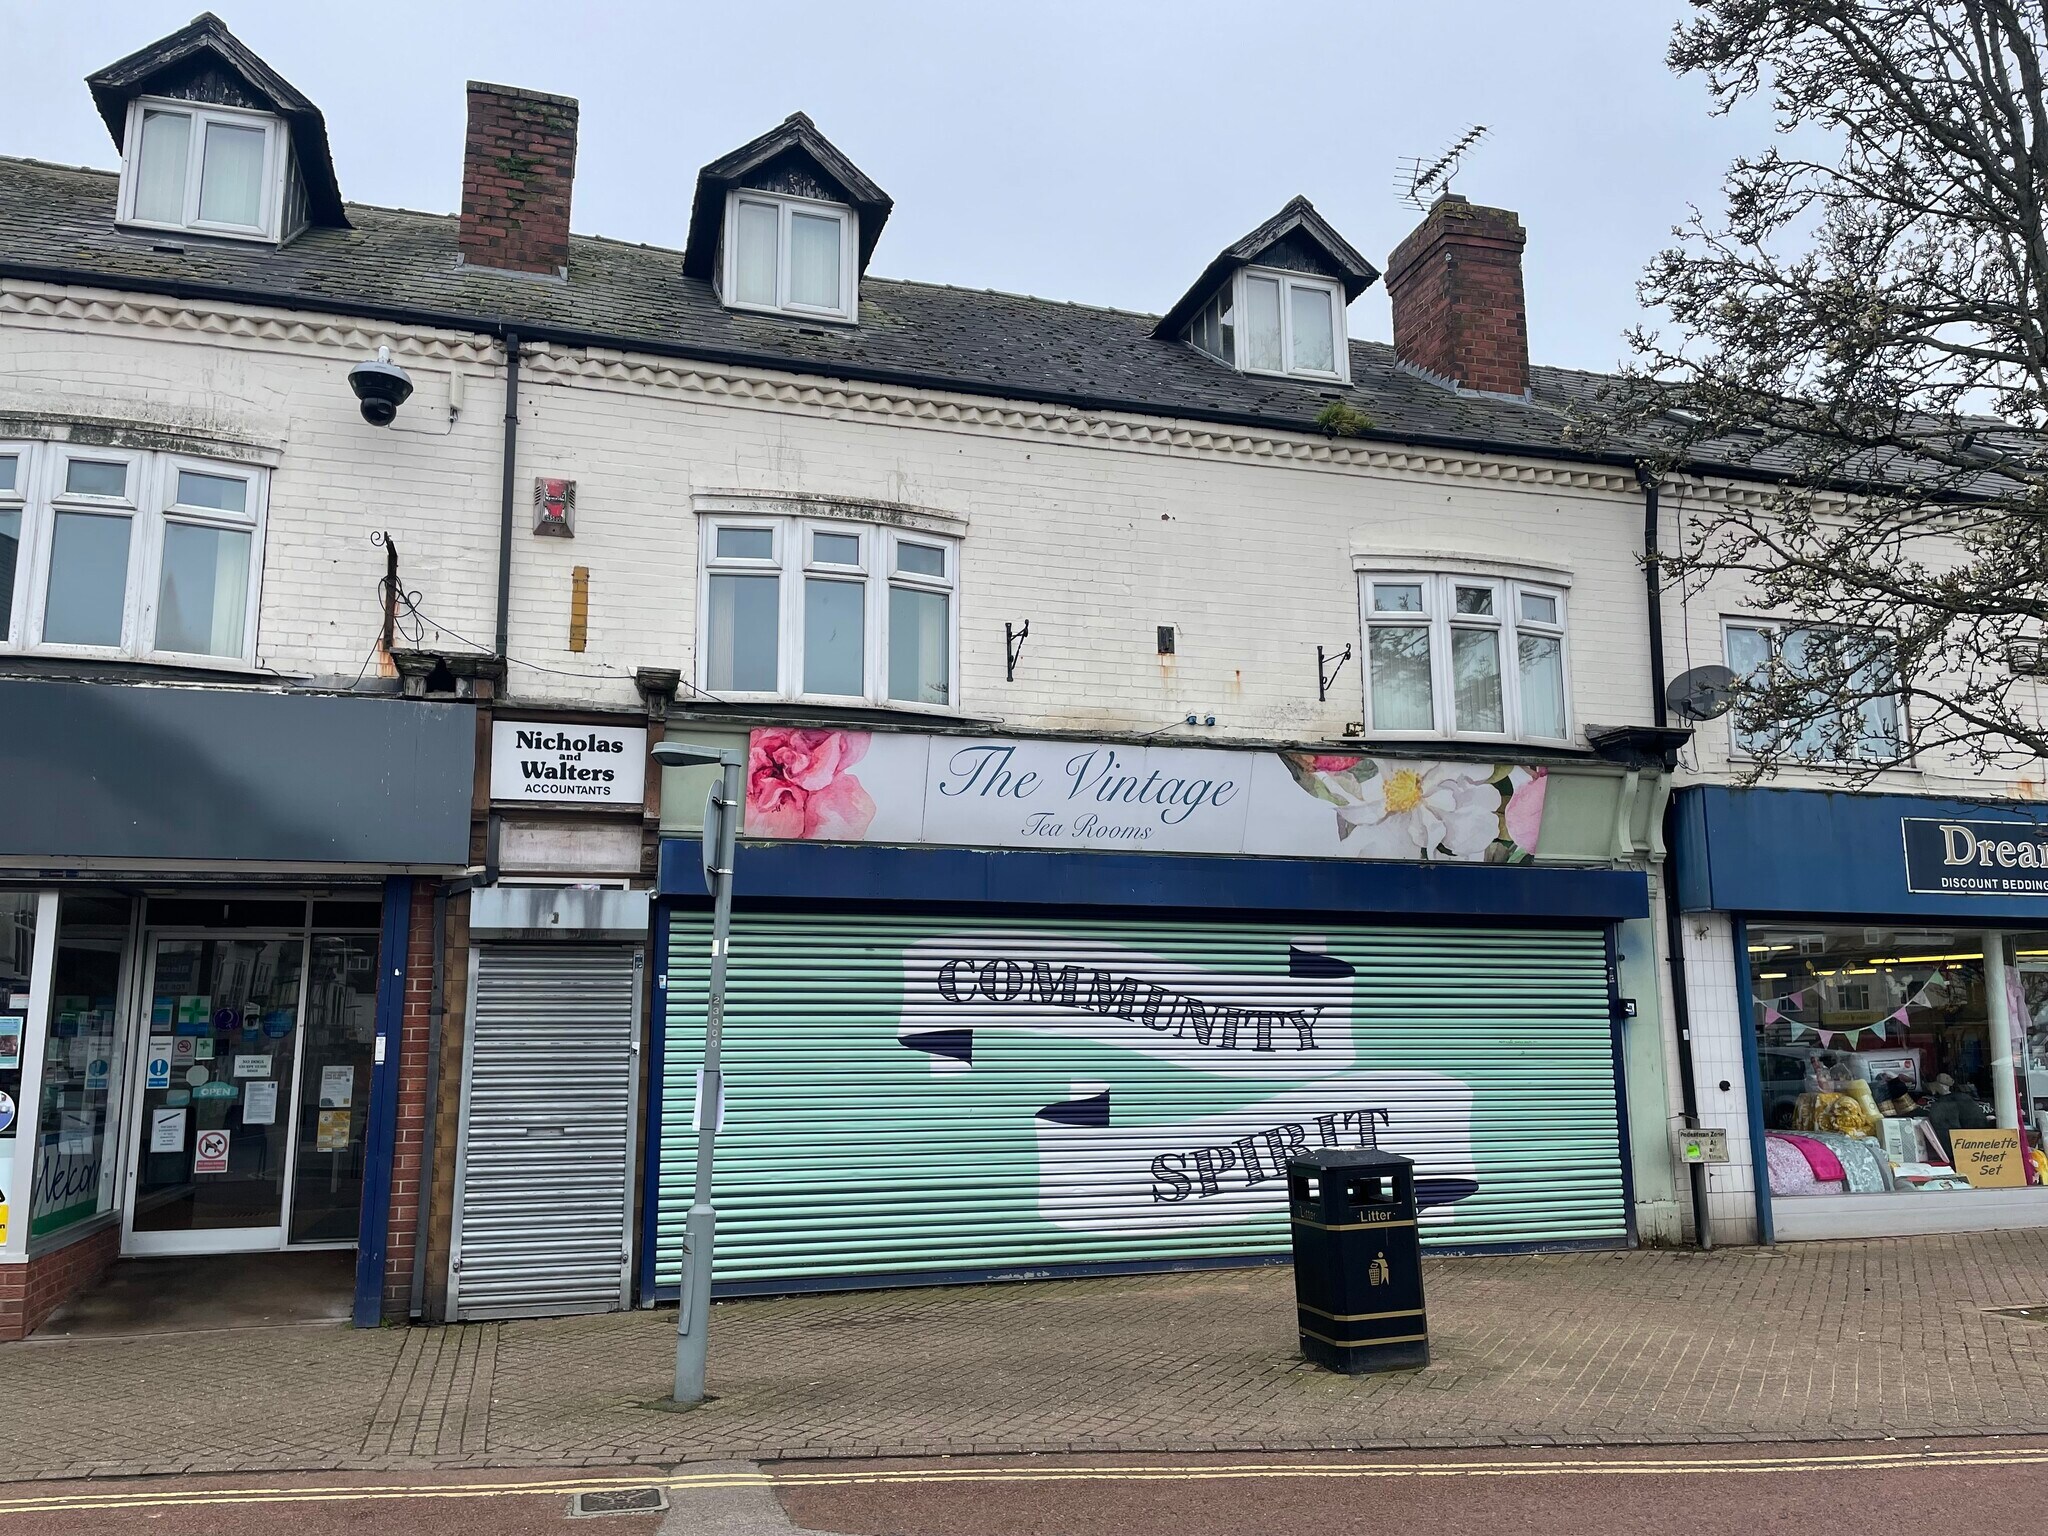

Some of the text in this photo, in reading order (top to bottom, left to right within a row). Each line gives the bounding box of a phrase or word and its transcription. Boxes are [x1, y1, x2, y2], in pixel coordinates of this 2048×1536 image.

[516, 731, 623, 753] Nicholas
[558, 753, 581, 761] and
[520, 761, 615, 781] Walters
[524, 784, 611, 796] ACCOUNTANTS
[939, 745, 1239, 825] The Vintage
[1021, 812, 1153, 840] Tea Rooms
[1941, 877, 1998, 889] DISCOUNT
[937, 958, 1324, 1052] COMMUNITY
[201, 1087, 231, 1096] OPEN
[1954, 1137, 2017, 1149] Flannelette
[1151, 1107, 1390, 1203] SPIRIT
[1970, 1151, 2007, 1162] Sheet
[1979, 1164, 2003, 1176] Set
[1360, 1210, 1392, 1222] Litter
